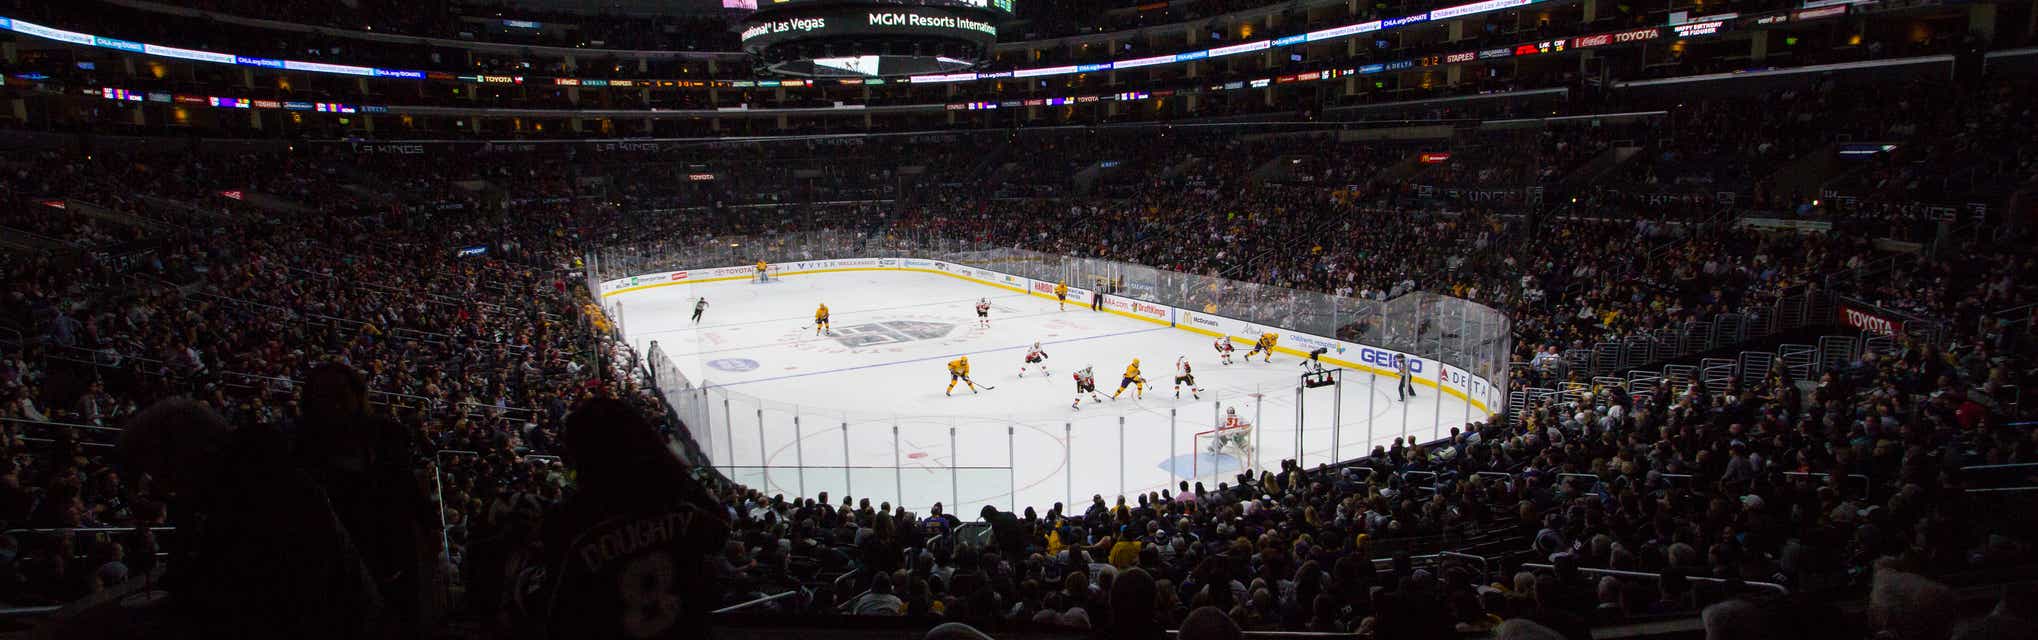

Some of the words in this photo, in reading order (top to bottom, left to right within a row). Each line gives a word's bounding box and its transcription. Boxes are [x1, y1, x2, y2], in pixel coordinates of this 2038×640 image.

[773, 21, 789, 33] Las
[790, 17, 825, 31] Vegas
[869, 13, 906, 26] MGM
[909, 14, 955, 28] Resorts
[1614, 30, 1659, 43] TOYOTA
[1447, 53, 1475, 63] STAPLES
[485, 76, 513, 84] TOYOTA
[1077, 96, 1099, 104] TOYOTA
[1138, 303, 1166, 318] DraftKings
[1846, 309, 1894, 336] TOYOTA
[1452, 372, 1487, 397] DETA
